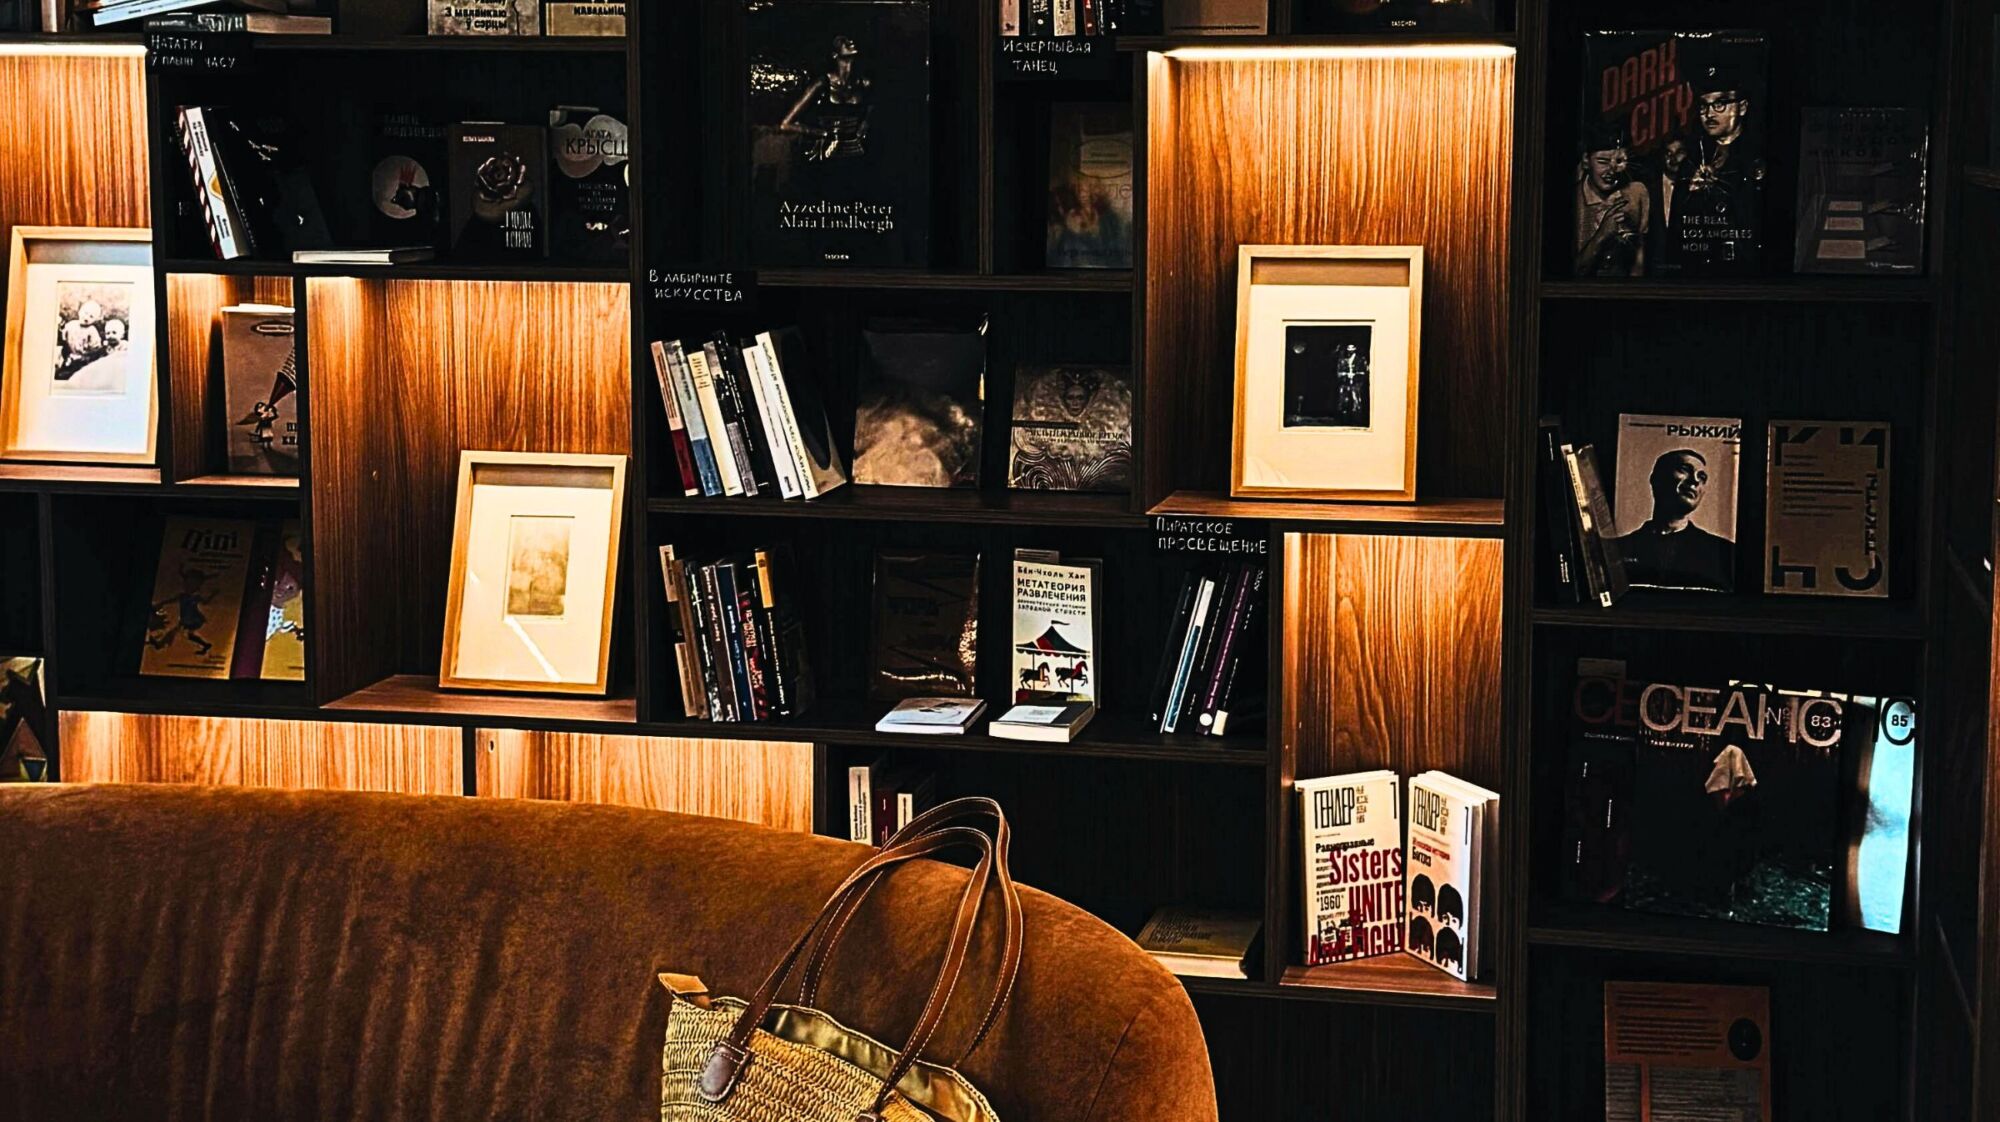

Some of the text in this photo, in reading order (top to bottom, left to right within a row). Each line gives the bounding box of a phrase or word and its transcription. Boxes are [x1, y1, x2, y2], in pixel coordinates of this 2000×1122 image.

[1391, 20, 1417, 28] TASCHEN
[1012, 59, 1059, 75] ТАНЕЦ
[1602, 36, 1678, 113] DARK
[1630, 79, 1695, 148] CITY
[854, 201, 893, 214] Peter
[820, 215, 894, 234] Lindbergh
[1682, 215, 1728, 225] THE REAL
[1682, 229, 1753, 239] LOS ANGELES
[1682, 243, 1709, 252] NOIR
[654, 287, 743, 302] ИСКУССТВА
[1667, 423, 1741, 439] РЫЖИЙ
[1156, 516, 1233, 535] ПИРАТСКОЕ
[1158, 536, 1267, 554] ПРОСВЕЩЕНИЕ
[1068, 571, 1086, 580] Хан
[1017, 578, 1086, 593] МЕТАТЕОРИЯ
[1017, 588, 1086, 603] РАЗВЛЕЧЕНИЯ
[1810, 714, 1832, 728] 83
[1891, 714, 1908, 727] 85
[1314, 787, 1355, 830] ГЕНДЕР
[1329, 847, 1403, 885] Sisters
